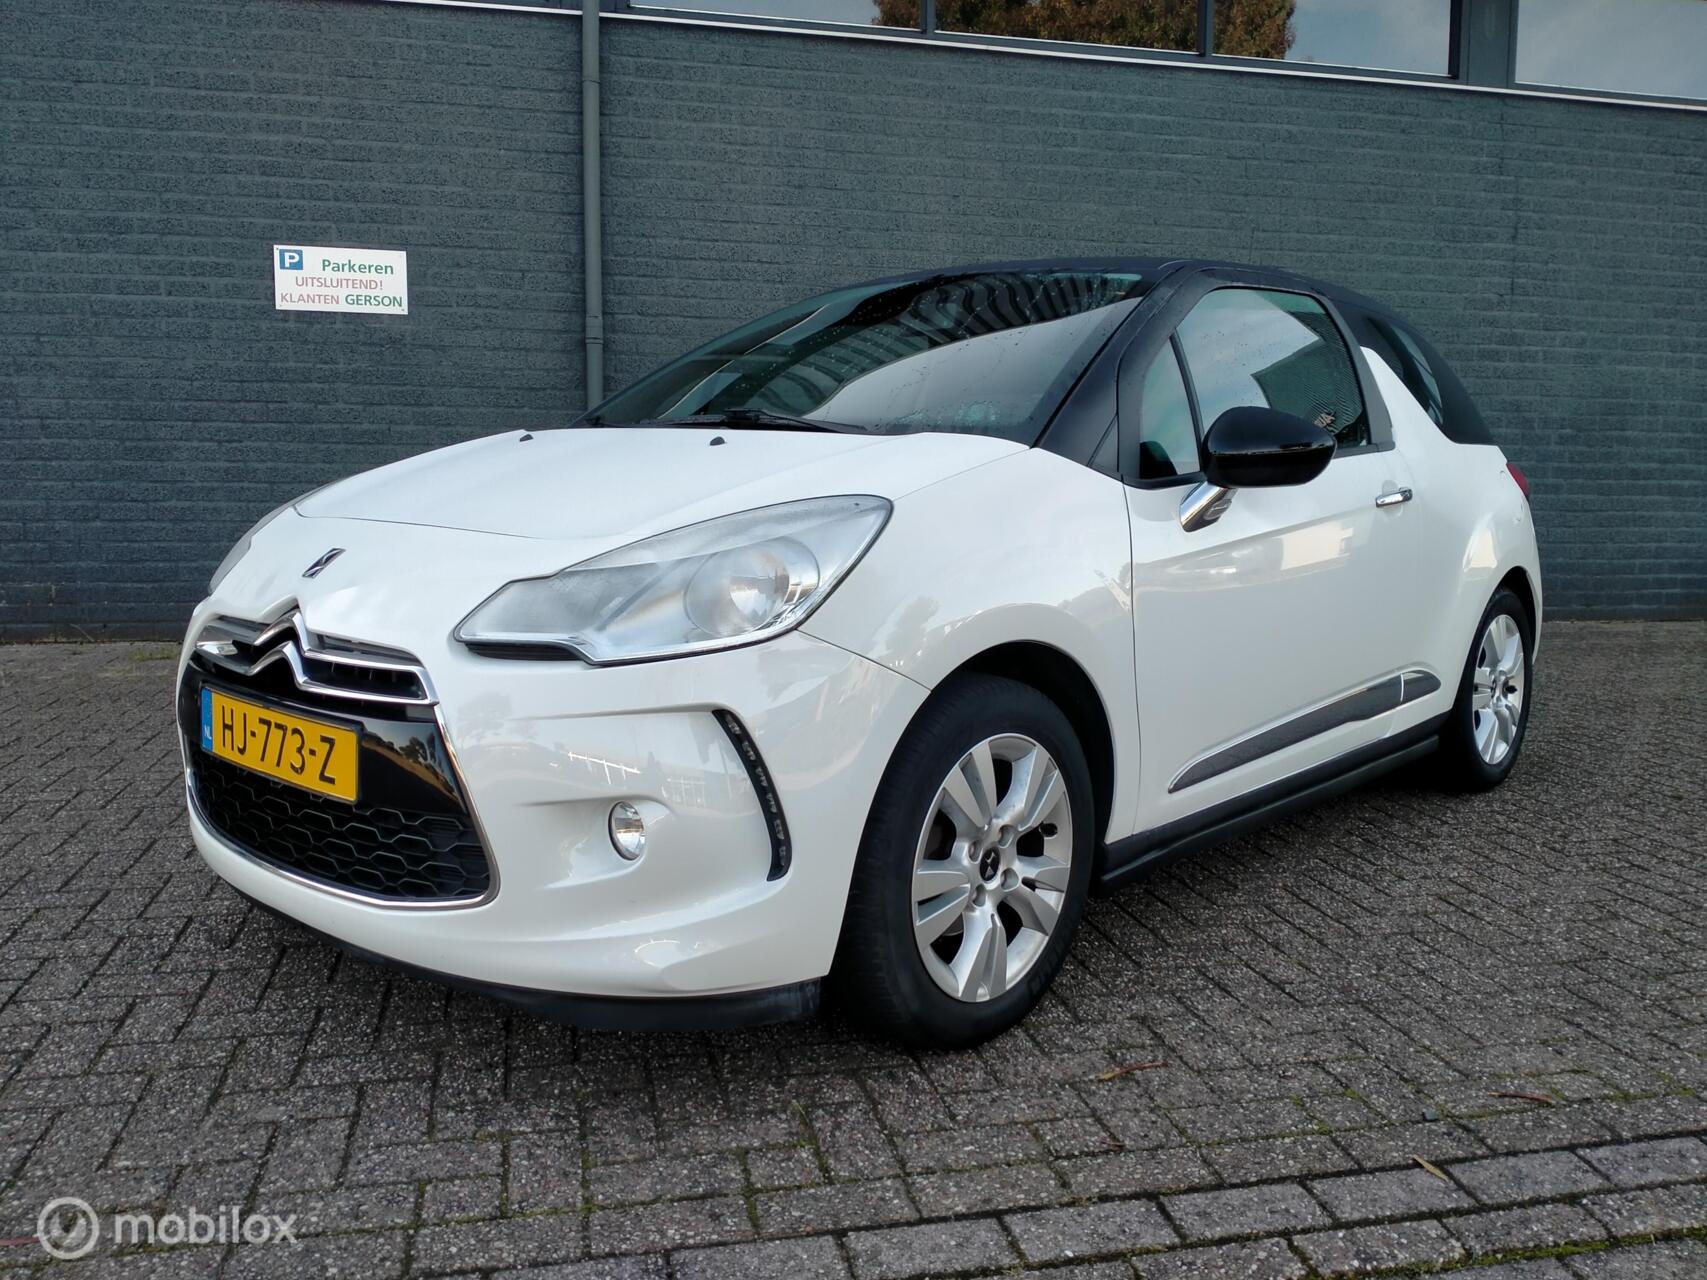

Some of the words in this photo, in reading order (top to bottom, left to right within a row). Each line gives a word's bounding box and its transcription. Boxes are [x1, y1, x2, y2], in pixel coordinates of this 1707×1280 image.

[284, 252, 300, 268] P
[321, 259, 394, 275] Parkeren
[295, 276, 383, 290] UITSLUITEND!
[280, 292, 340, 305] KLANTEN
[345, 293, 403, 307] GERSON
[222, 705, 336, 785] HJ-773-Z
